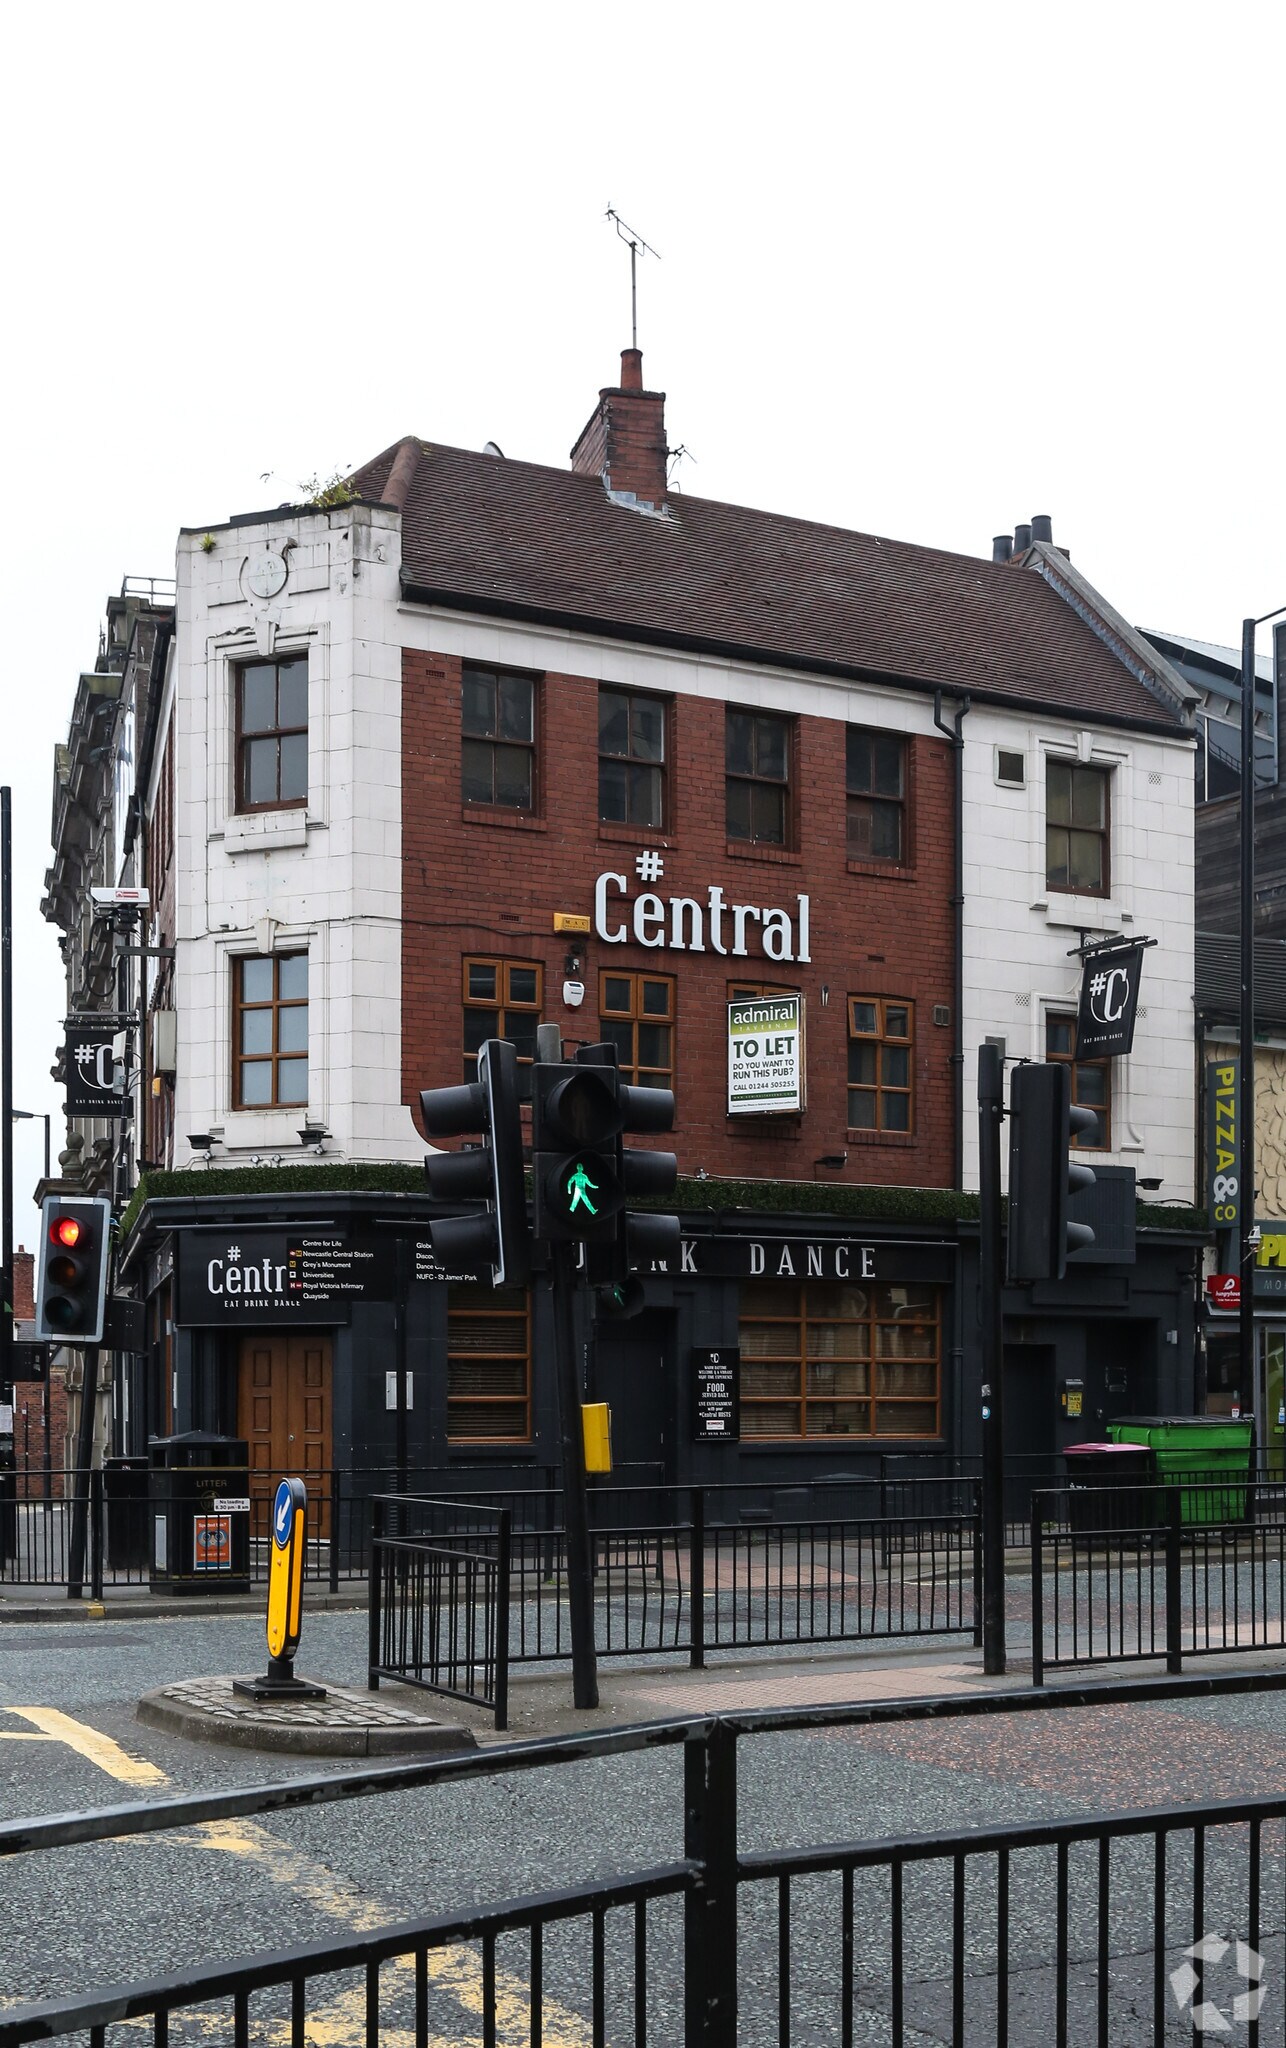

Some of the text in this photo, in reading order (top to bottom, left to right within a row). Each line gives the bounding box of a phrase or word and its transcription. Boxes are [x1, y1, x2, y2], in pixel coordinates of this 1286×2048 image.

[734, 1003, 794, 1024] admiral
[739, 1023, 788, 1031] TAVERNS
[733, 1036, 794, 1058] TO LET
[733, 1068, 794, 1080] RUN THIS PUB?
[1216, 1066, 1235, 1173] PIZZA
[1214, 1205, 1236, 1220] CO
[302, 1261, 321, 1269] Grey's
[750, 1243, 876, 1278] DANCE
[208, 1258, 287, 1294] Centr
[706, 1383, 725, 1392] FOOD
